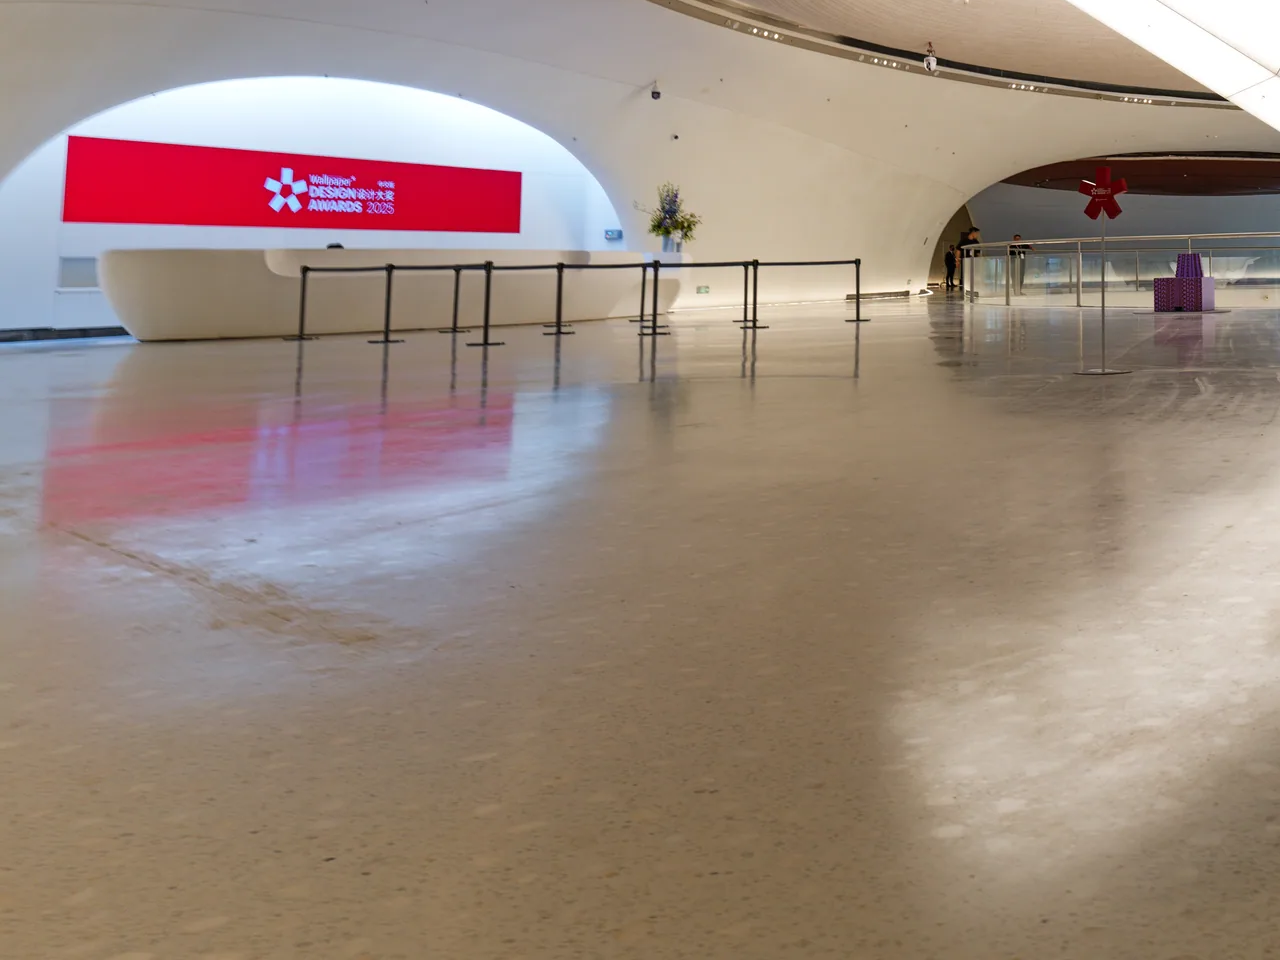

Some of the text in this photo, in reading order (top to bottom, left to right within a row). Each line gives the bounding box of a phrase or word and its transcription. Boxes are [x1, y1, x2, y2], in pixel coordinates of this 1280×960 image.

[308, 185, 356, 200] DESIGN
[307, 199, 394, 215] AWARDS 2025
